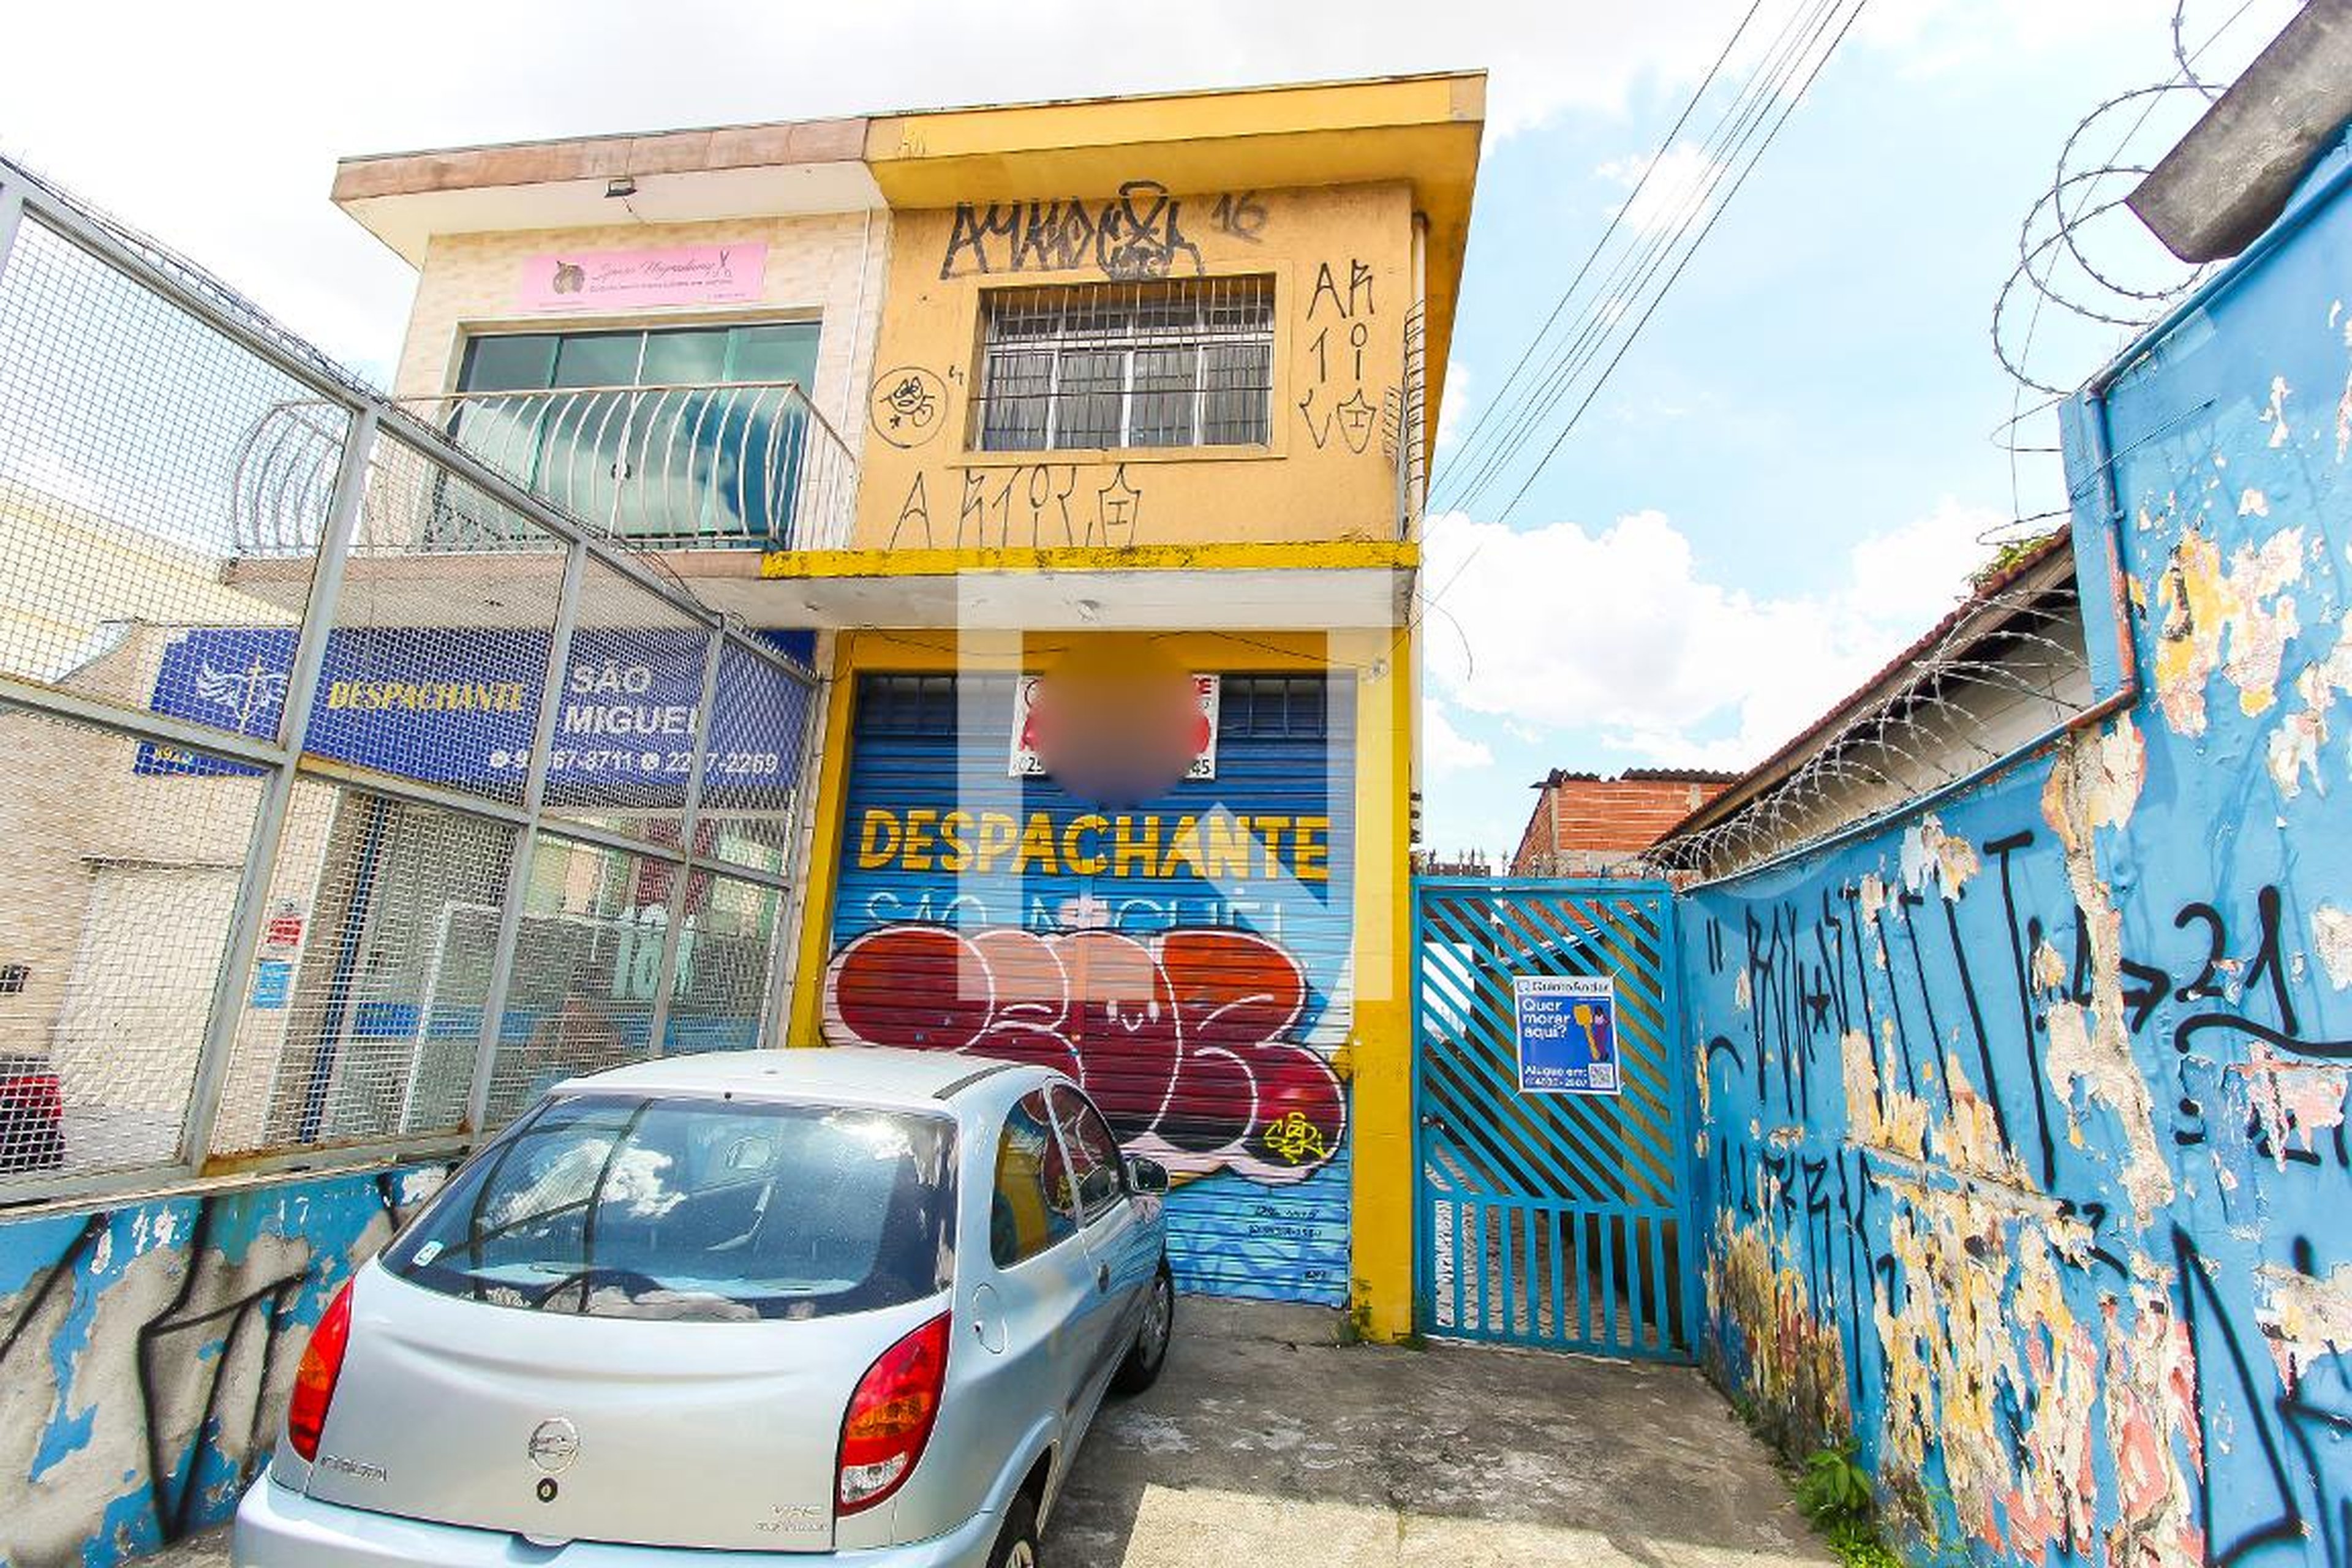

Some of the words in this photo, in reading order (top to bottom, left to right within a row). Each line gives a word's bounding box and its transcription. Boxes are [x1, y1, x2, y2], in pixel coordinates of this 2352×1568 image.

[328, 681, 522, 710] DESPACHANTE
[666, 752, 778, 774] 227-2269
[859, 809, 1331, 880] DESPACHANTE
[1522, 998, 1563, 1012] Quer
[1523, 1014, 1570, 1025] morar
[1524, 1024, 1567, 1040] aqui?
